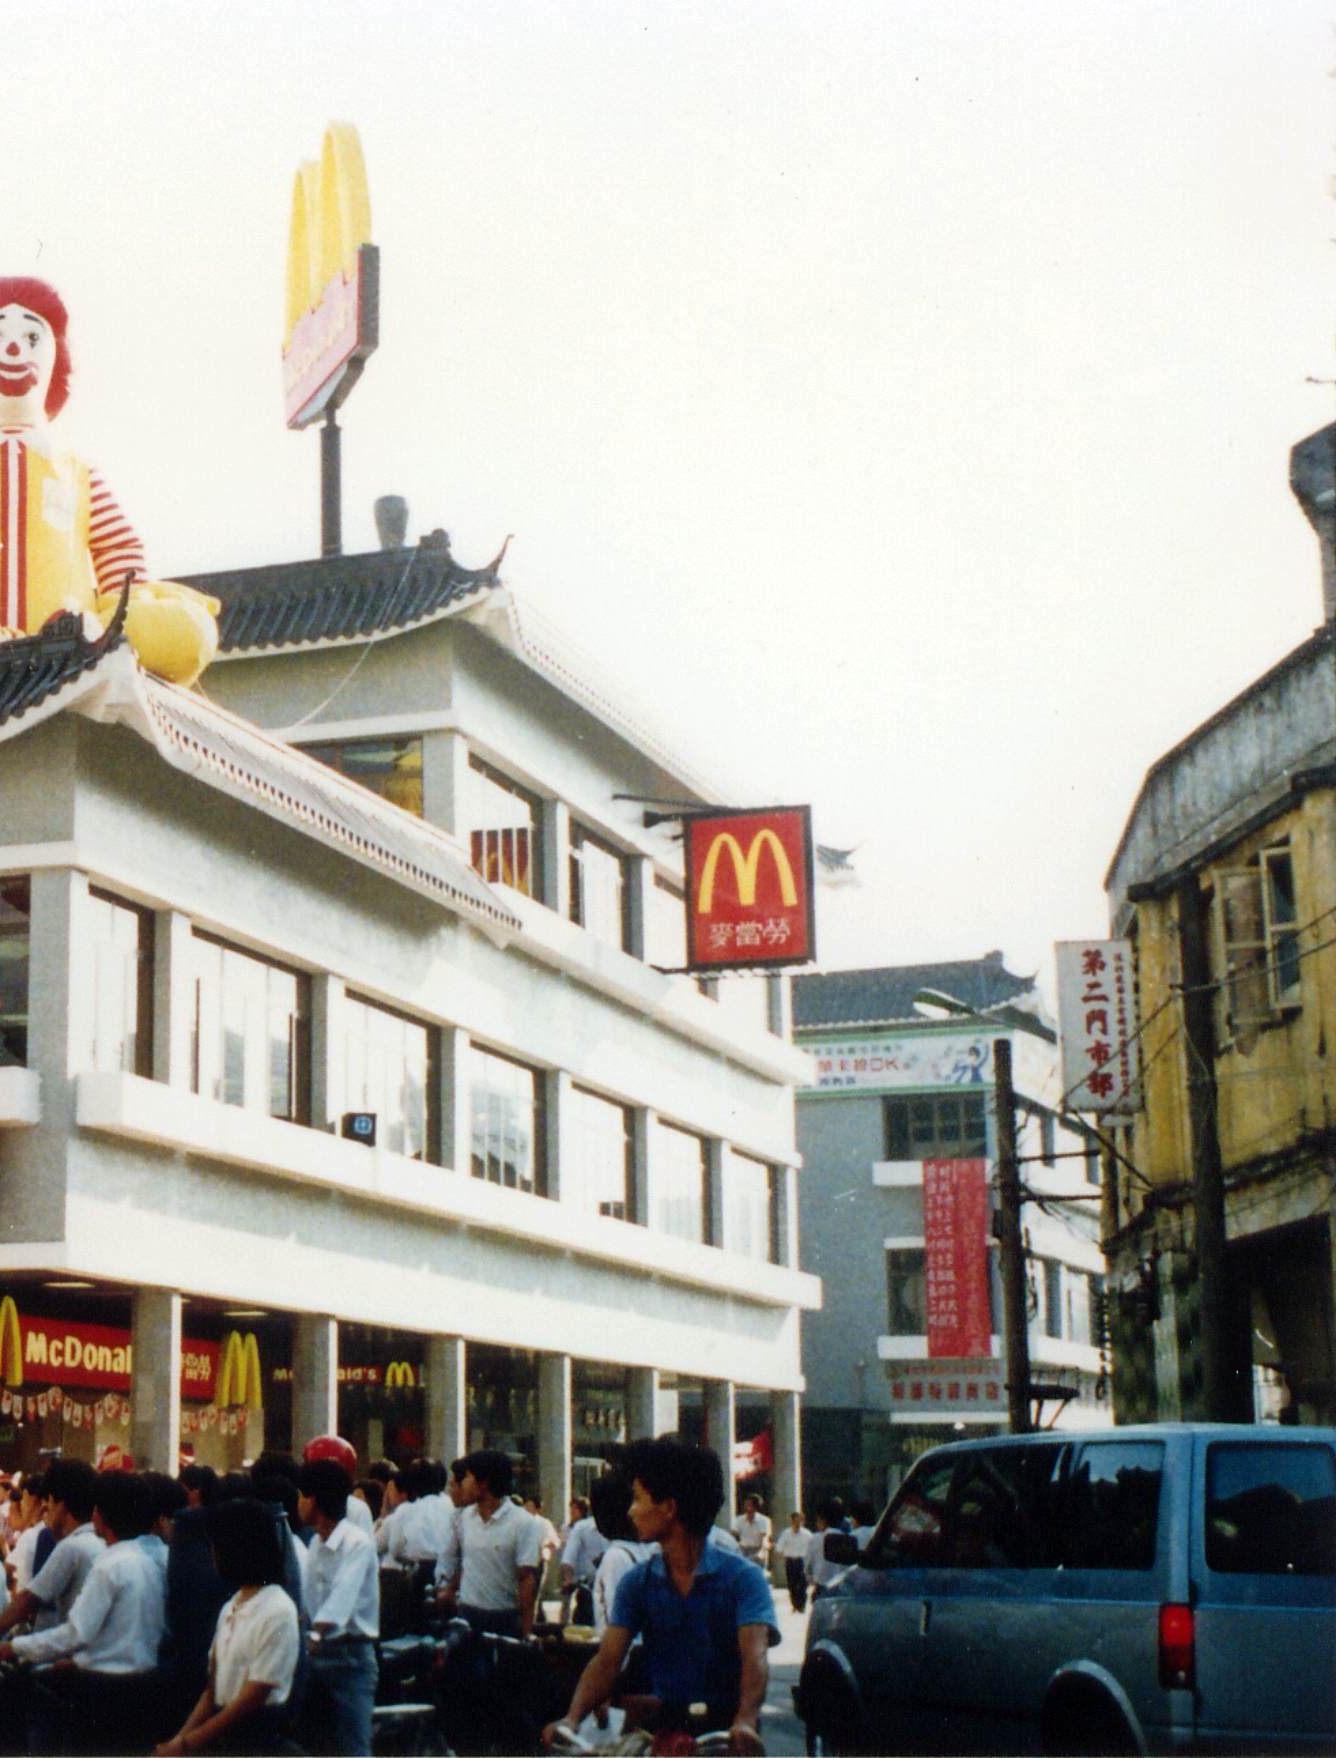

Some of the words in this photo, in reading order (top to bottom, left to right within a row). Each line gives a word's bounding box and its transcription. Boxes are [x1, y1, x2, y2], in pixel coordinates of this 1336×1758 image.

[709, 918, 791, 949] 麥當勞
[25, 1331, 131, 1374] McDonal
